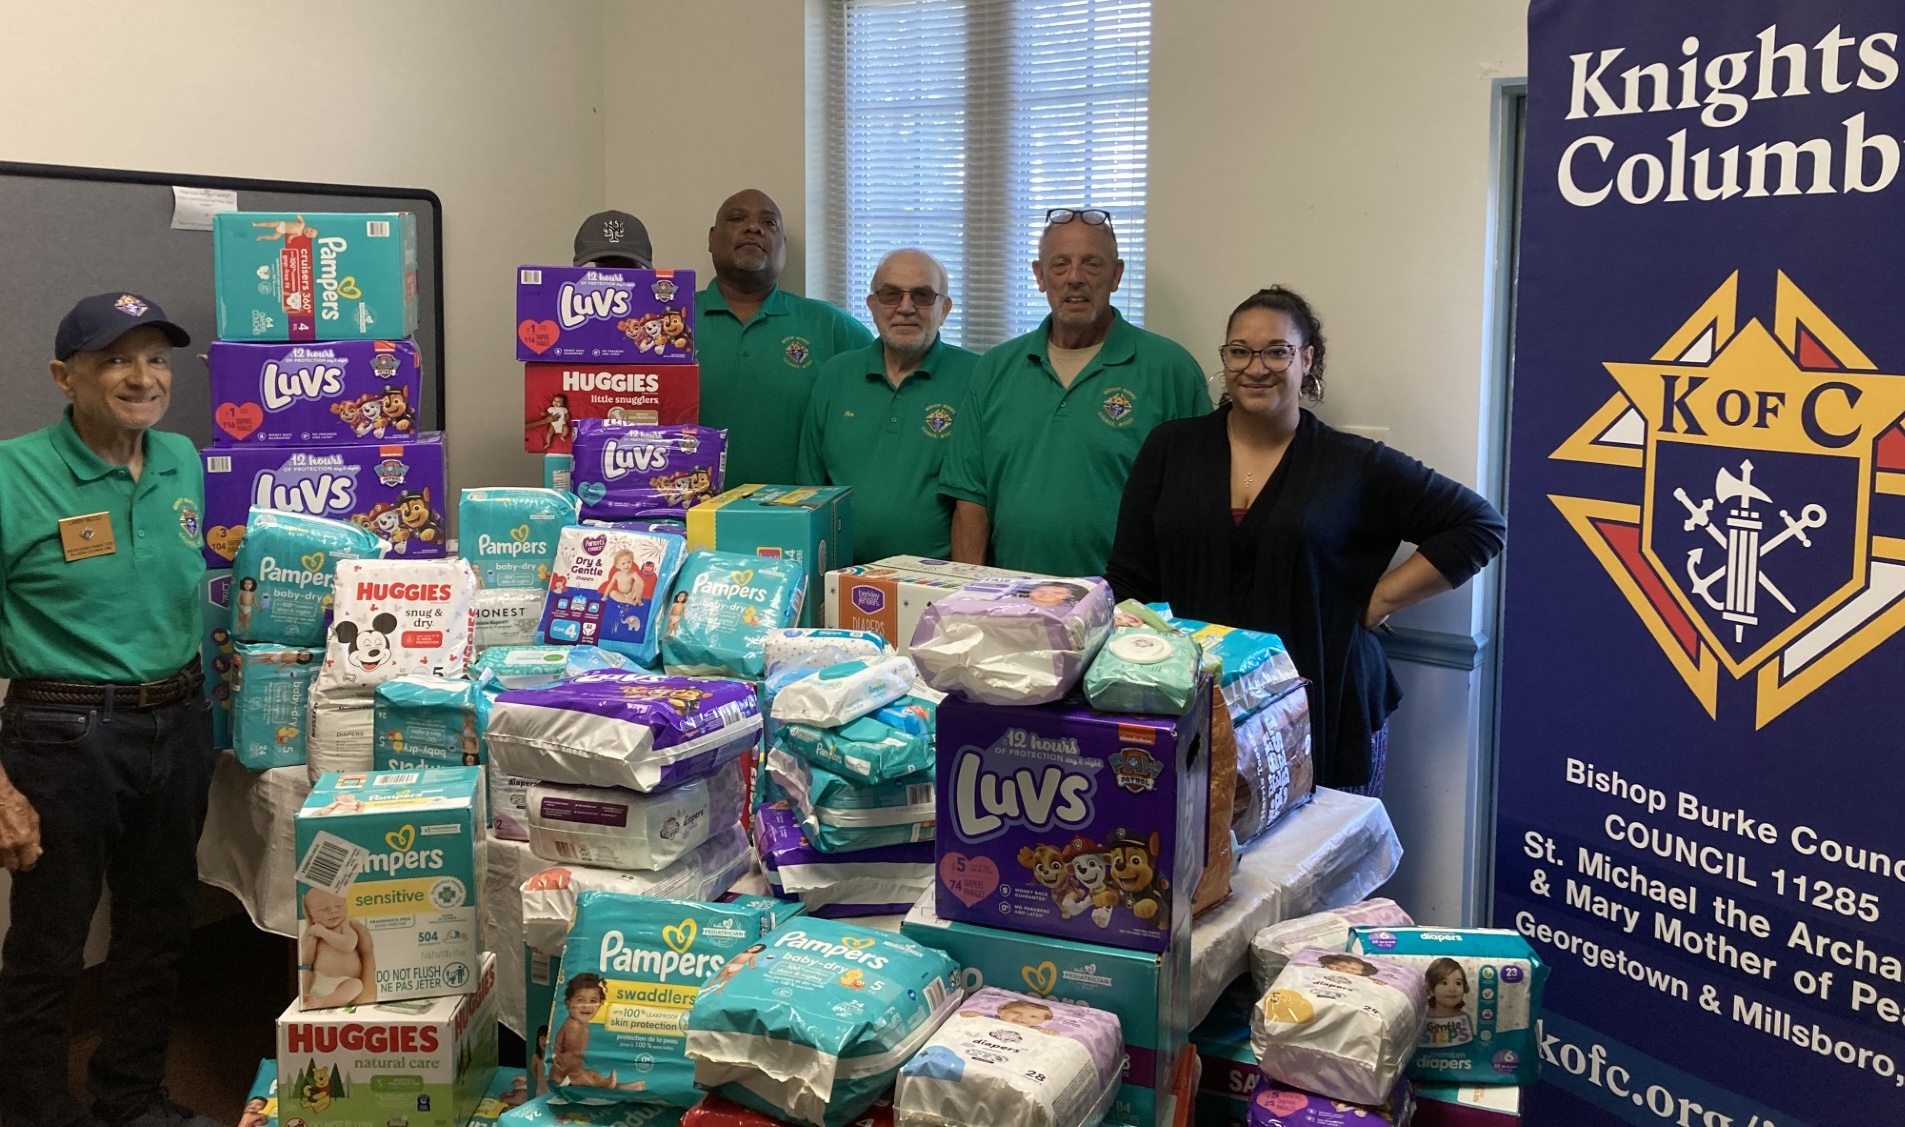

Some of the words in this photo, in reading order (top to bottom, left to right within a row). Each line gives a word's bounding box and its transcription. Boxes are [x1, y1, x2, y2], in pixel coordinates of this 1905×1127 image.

[1564, 24, 1899, 128] Knights
[1557, 111, 1905, 207] Columb
[300, 249, 309, 289] cruisers
[316, 237, 347, 320] Pampers
[586, 272, 597, 280] 12
[599, 272, 623, 281] hours
[561, 286, 629, 327] Luvs
[298, 322, 309, 331] 4
[292, 348, 304, 358] 12
[306, 348, 334, 358] hours
[263, 363, 341, 409] Luvs
[563, 371, 660, 392] HUGGIES
[591, 395, 613, 404] little
[614, 395, 660, 406] snugglers
[1657, 374, 1711, 436] K
[1801, 381, 1863, 449] C
[292, 456, 306, 466] 12
[308, 455, 341, 466] hours
[604, 441, 667, 479] Luvs
[220, 528, 227, 537] 3
[478, 534, 547, 560] Pampers
[496, 563, 536, 575] baby-dry
[576, 557, 593, 567] Dry
[595, 559, 602, 567] &
[571, 566, 603, 576] Gentle
[356, 582, 452, 601] HUGGIES
[692, 573, 768, 602] Pampers
[858, 589, 880, 600] berkley
[273, 589, 323, 603] baby-dry
[405, 609, 432, 618] snug
[434, 608, 443, 617] &
[413, 618, 433, 629] dry
[852, 616, 885, 633] DIAPERS
[564, 623, 577, 639] 4
[433, 667, 444, 677] 5
[288, 681, 303, 727] baby-dry
[379, 736, 385, 747] 5
[1006, 730, 1027, 748] 12
[1030, 735, 1077, 754] hours
[403, 744, 447, 758] baby-dry
[816, 742, 842, 764] Pampers
[1008, 749, 1063, 762] PROTECTION
[1108, 751, 1165, 779] PAW
[1121, 776, 1150, 787] PATROL
[368, 793, 424, 802] Pampers
[957, 752, 1089, 836] Luvs
[1566, 757, 1667, 814] Bishop
[1677, 791, 1778, 844] Burke
[496, 820, 503, 829] 2
[683, 809, 704, 826] diapers
[360, 849, 443, 876] mpers
[956, 857, 966, 872] 5
[1605, 814, 1757, 887] COUNCIL
[1771, 869, 1880, 922] 11285
[950, 880, 962, 891] 74
[355, 889, 424, 906] sensitive
[1523, 831, 1564, 866] St.
[1578, 847, 1697, 914] Michael
[1713, 896, 1771, 938] the
[1787, 921, 1905, 983] Archa
[418, 931, 438, 942] 504
[704, 929, 744, 938] PEDIATRICIAN
[1420, 933, 1463, 943] diapers
[774, 931, 889, 970] Pampers
[1529, 868, 1551, 897] &
[1566, 879, 1640, 933] Mary
[1654, 912, 1777, 980] Mother
[1793, 972, 1833, 1000] of
[1851, 980, 1905, 1027] Pe
[600, 930, 725, 982] Pampers
[782, 952, 848, 974] baby-dry
[376, 970, 390, 982] DO
[392, 968, 410, 981] NOT
[413, 966, 441, 980] FLUSH
[1064, 972, 1110, 985] PEDIATRICIAN
[1505, 968, 1518, 976] 23
[381, 983, 393, 993] NE
[395, 981, 413, 991] PAS
[415, 979, 441, 990] JETER
[870, 980, 885, 991] 5
[1313, 981, 1354, 992] diapers
[454, 962, 496, 1044] HUGGIES
[616, 988, 697, 1006] swaddlers
[1269, 992, 1281, 1003] 5
[1515, 911, 1689, 1001] Georgetown
[1699, 985, 1722, 1015] &
[1732, 994, 1905, 1088] Millsboro,
[646, 1012, 679, 1020] LEAKPROOF
[1362, 1005, 1379, 1014] 24
[611, 1017, 629, 1027] skin
[631, 1020, 677, 1031] protection
[1427, 1021, 1462, 1032] Gentle
[288, 1024, 439, 1054] HUGGIES
[616, 1034, 646, 1042] protection
[663, 1037, 679, 1045] peau
[1421, 1028, 1469, 1044] STEPS
[972, 1039, 1020, 1054] diapers
[1429, 1051, 1466, 1059] premium
[1504, 1050, 1514, 1062] 6
[354, 1056, 407, 1069] natural
[409, 1059, 440, 1069] care
[1416, 1055, 1472, 1071] diapers
[1025, 1069, 1046, 1081] 28
